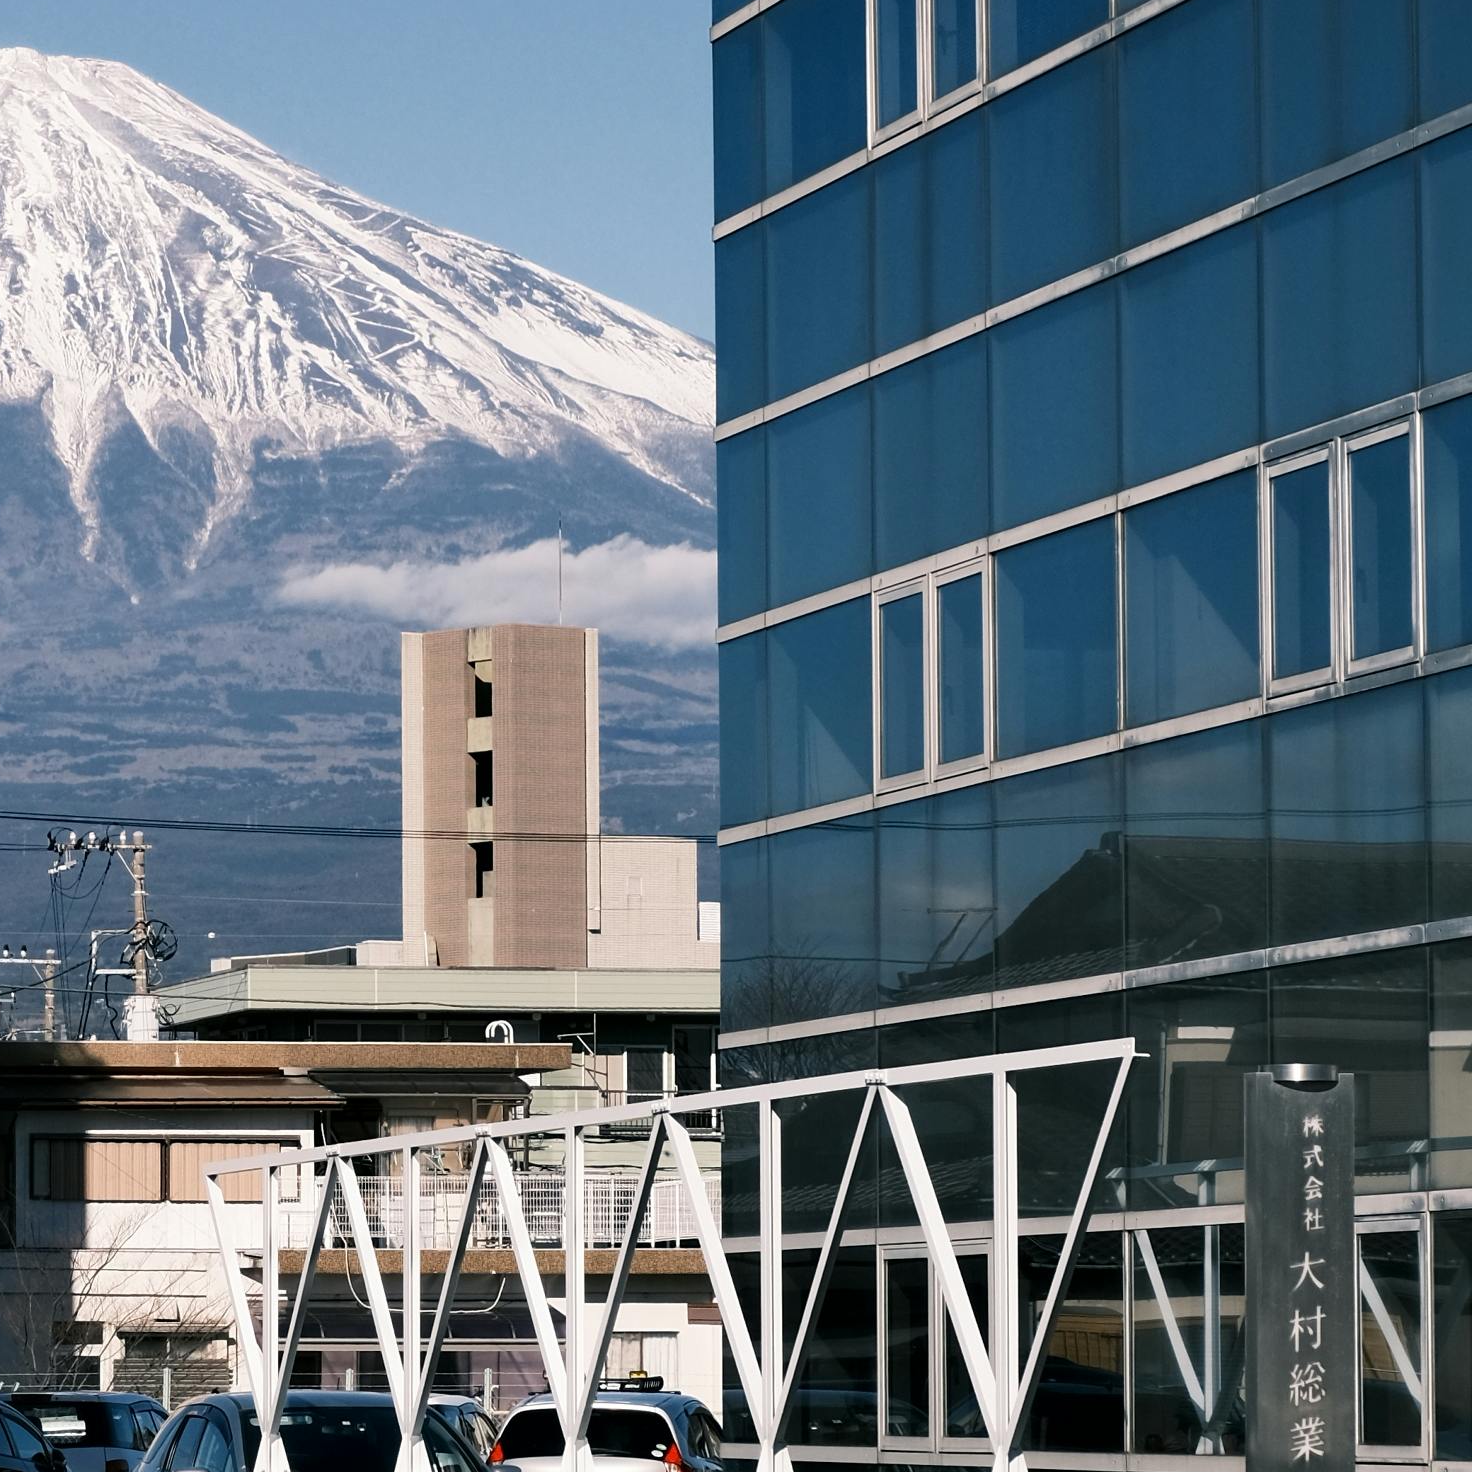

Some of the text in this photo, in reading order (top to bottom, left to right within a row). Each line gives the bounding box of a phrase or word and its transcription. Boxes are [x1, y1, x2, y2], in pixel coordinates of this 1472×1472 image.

[1288, 1113, 1327, 1463] 株式会社 大村総業
